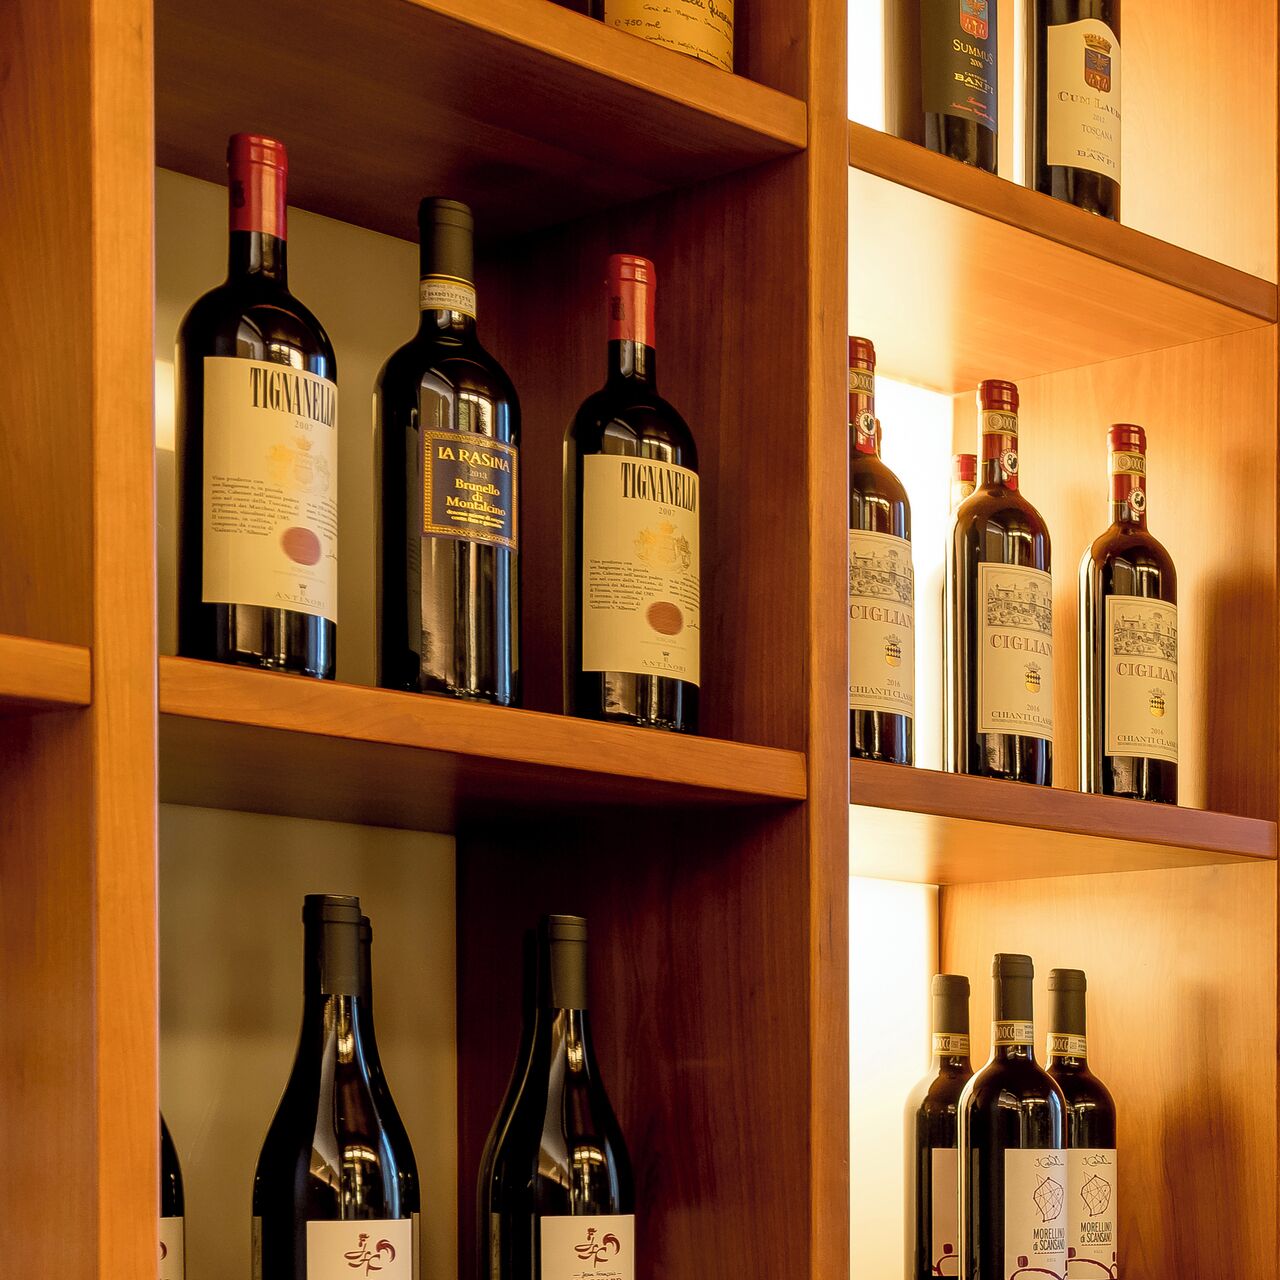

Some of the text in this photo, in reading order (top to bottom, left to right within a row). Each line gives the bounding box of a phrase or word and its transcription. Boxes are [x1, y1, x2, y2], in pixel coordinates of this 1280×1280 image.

[953, 39, 994, 65] SUMMUS
[954, 72, 994, 94] BANFI
[1058, 91, 1121, 120] CUM LAUD
[1081, 124, 1112, 142] TOSCANA
[1077, 149, 1116, 168] BANFI
[249, 366, 336, 431] TIGNANELLO
[295, 420, 313, 432] 2007
[438, 446, 455, 461] LA
[455, 478, 500, 496] Brunello
[621, 462, 697, 513] TIGNANELLO
[472, 491, 483, 502] di
[446, 495, 506, 517] Montalcino
[658, 506, 675, 516] 2007
[275, 591, 325, 608] ANTINORI
[849, 603, 913, 629] CIGLIAN
[990, 633, 1053, 657] CIGLIAN
[641, 659, 686, 672] ANTINORI
[1116, 662, 1178, 685] CIGLIAN
[886, 678, 900, 687] 2016
[849, 685, 891, 697] CHIANTI
[1026, 703, 1040, 712] 2016
[991, 710, 1031, 721] CHIANTI
[1117, 735, 1155, 744] CHIANTI
[1033, 1227, 1064, 1240] MORELLINO
[1080, 1221, 1112, 1233] MORELLINO
[1033, 1239, 1064, 1251] di SCANSANO
[1080, 1232, 1112, 1243] di SCANSANO
